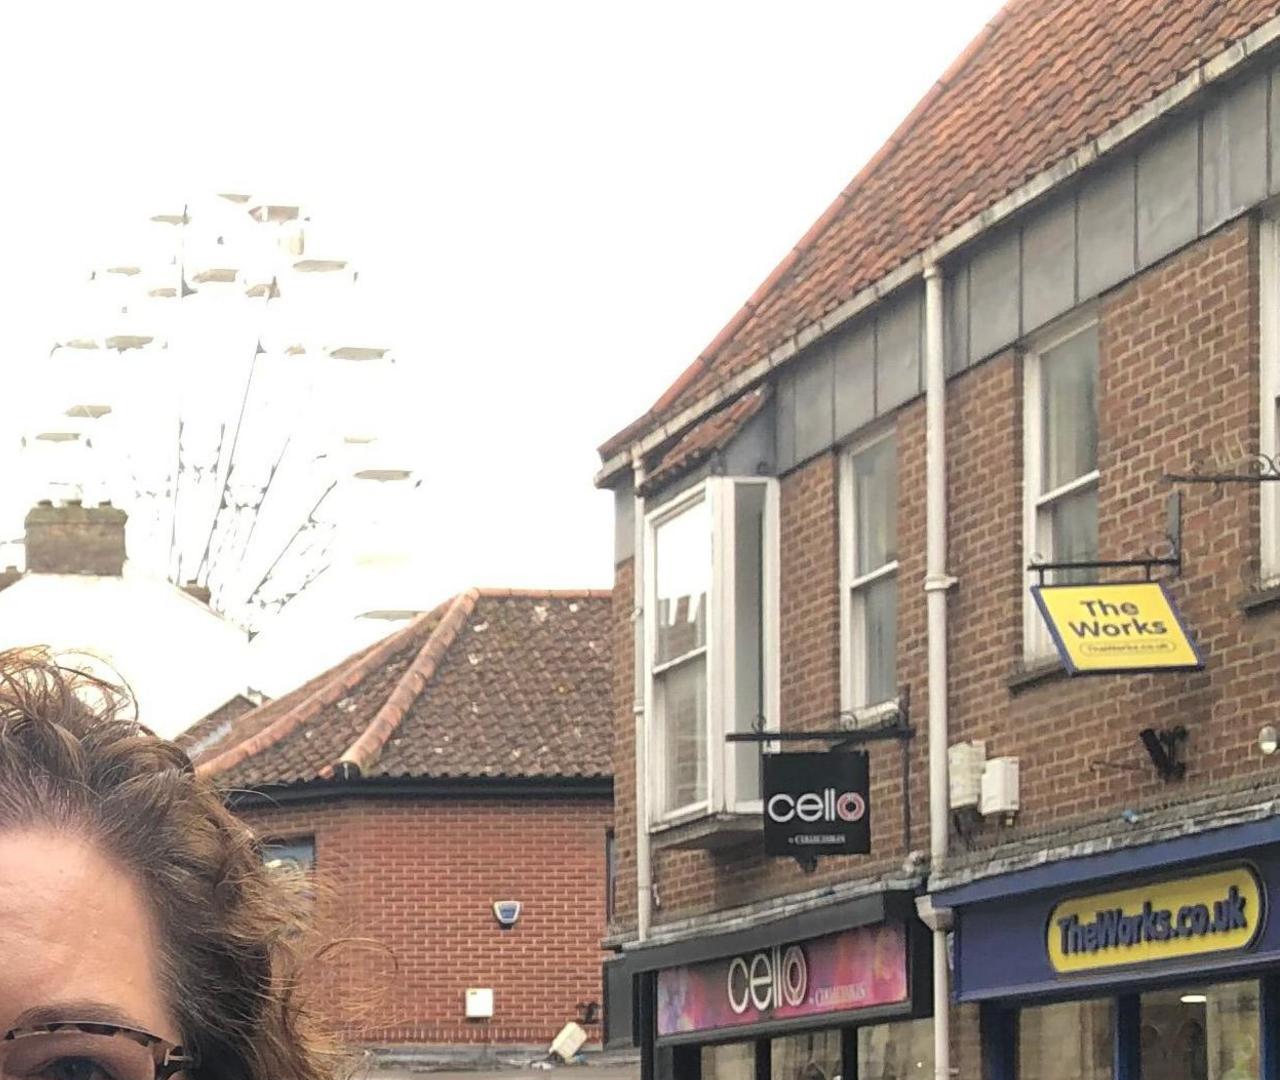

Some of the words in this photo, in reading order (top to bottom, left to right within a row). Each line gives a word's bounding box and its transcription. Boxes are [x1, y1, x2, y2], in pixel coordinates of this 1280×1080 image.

[1079, 598, 1140, 618] The
[1068, 618, 1168, 639] Works
[767, 788, 865, 822] cello
[1057, 884, 1248, 957] TheWorks.co.uk
[727, 945, 807, 1014] cello
